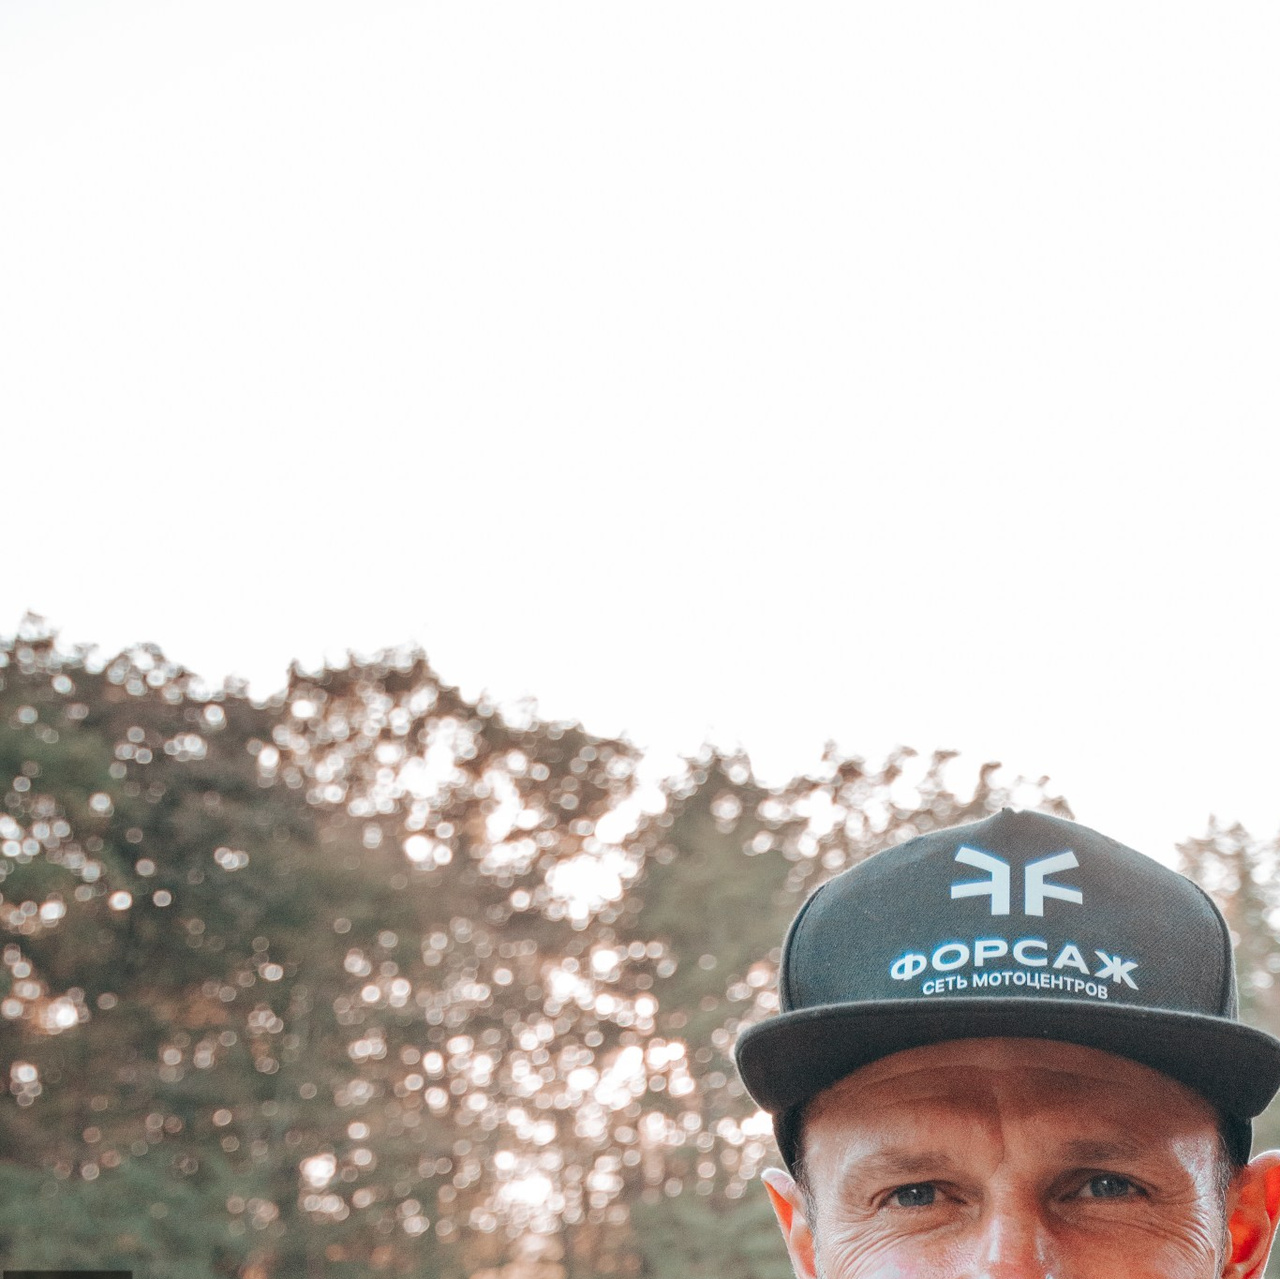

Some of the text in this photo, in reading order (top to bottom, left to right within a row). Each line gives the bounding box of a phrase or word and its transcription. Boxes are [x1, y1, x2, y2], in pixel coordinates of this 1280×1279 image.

[890, 939, 1140, 992] ФОРСАЖ
[922, 971, 1109, 1000] СЕТЬ МОТОЦЕНТРОВ
